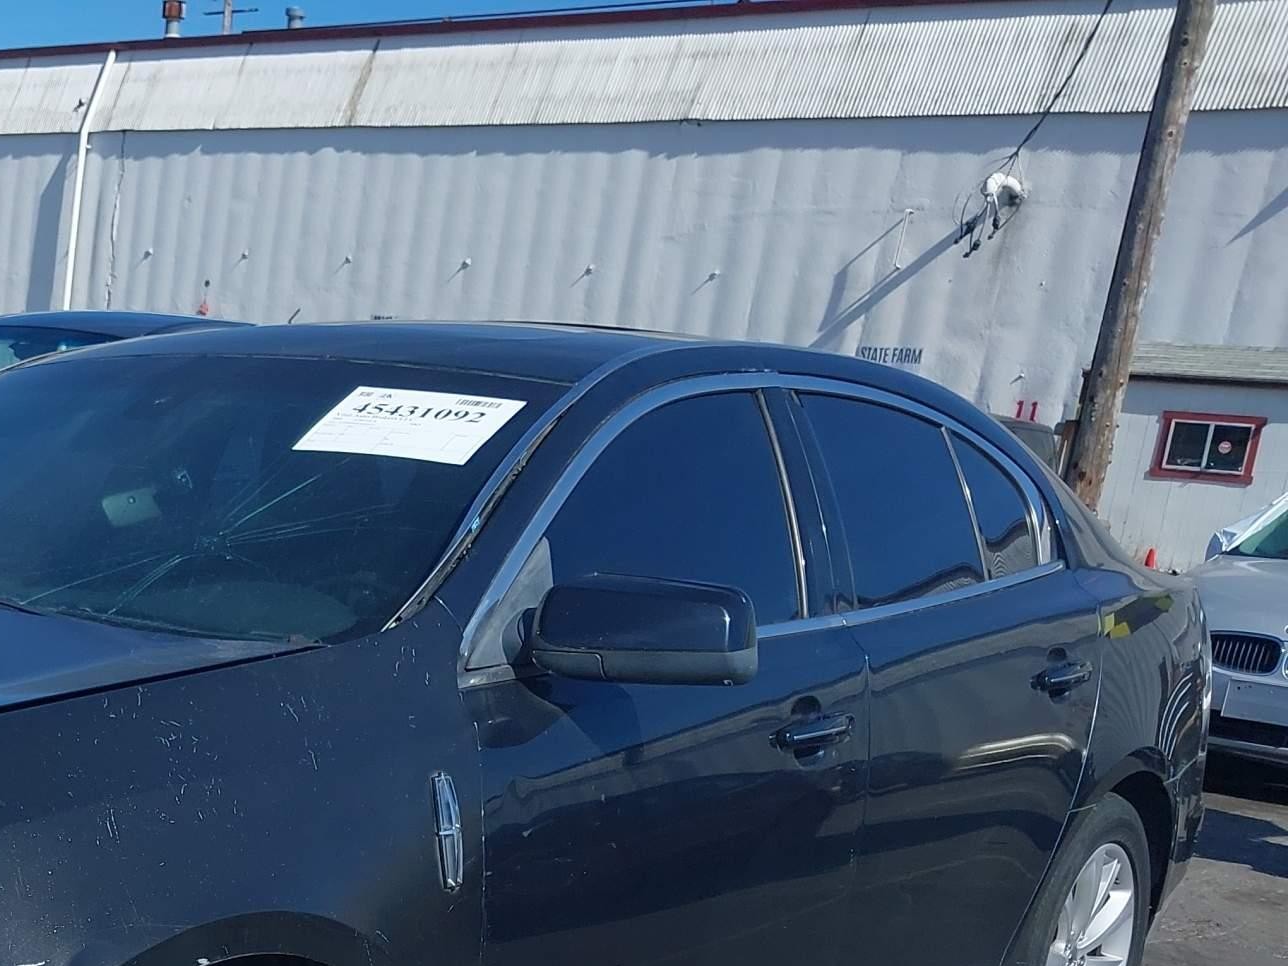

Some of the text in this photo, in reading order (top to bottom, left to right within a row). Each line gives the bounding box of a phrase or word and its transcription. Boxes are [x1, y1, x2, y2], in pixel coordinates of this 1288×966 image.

[861, 347, 923, 365] STATE FARM
[352, 402, 486, 423] 45431092
[1016, 400, 1038, 422] 11
